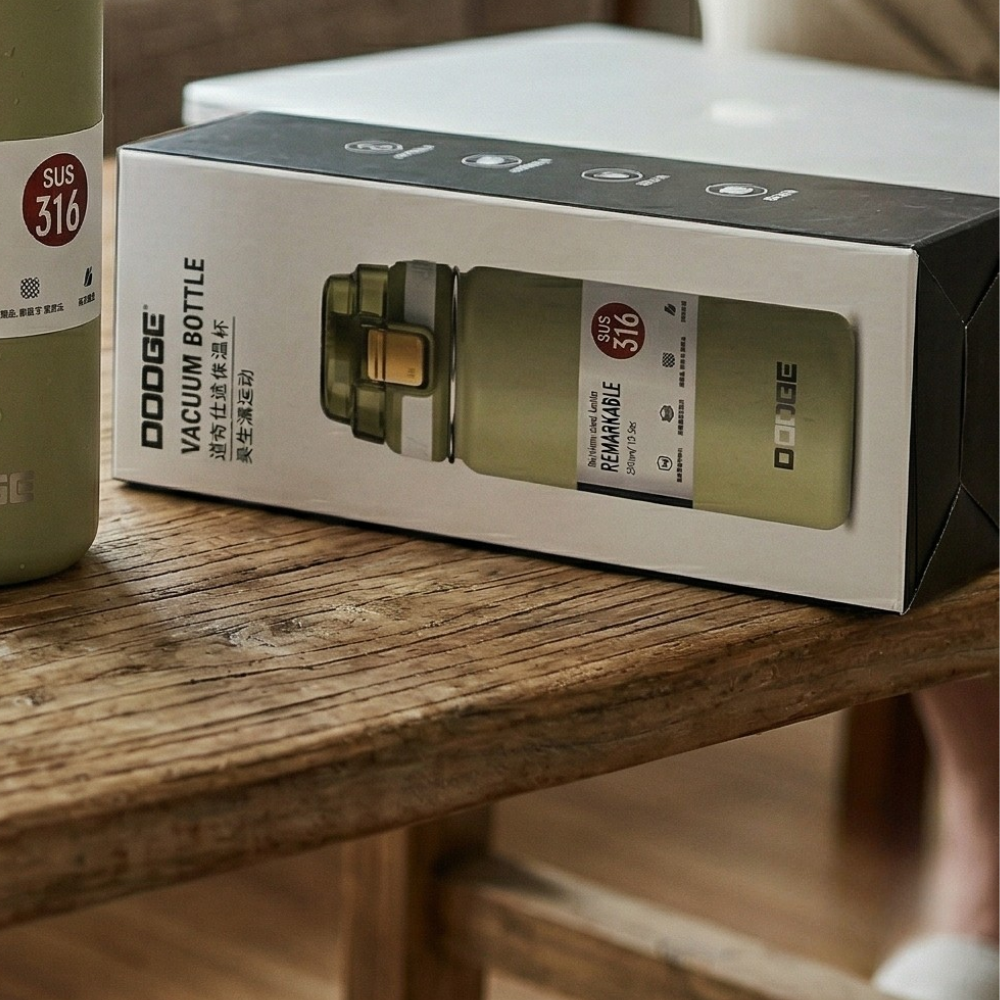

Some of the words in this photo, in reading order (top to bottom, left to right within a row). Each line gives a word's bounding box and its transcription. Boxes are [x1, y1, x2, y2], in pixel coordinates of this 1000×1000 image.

[43, 163, 75, 189] SUS
[35, 188, 80, 237] 316
[183, 256, 205, 347] BOTTLE
[597, 314, 611, 343] SUS
[613, 312, 640, 352] 316
[141, 311, 165, 450] DODGE
[181, 353, 202, 455] VACUUM
